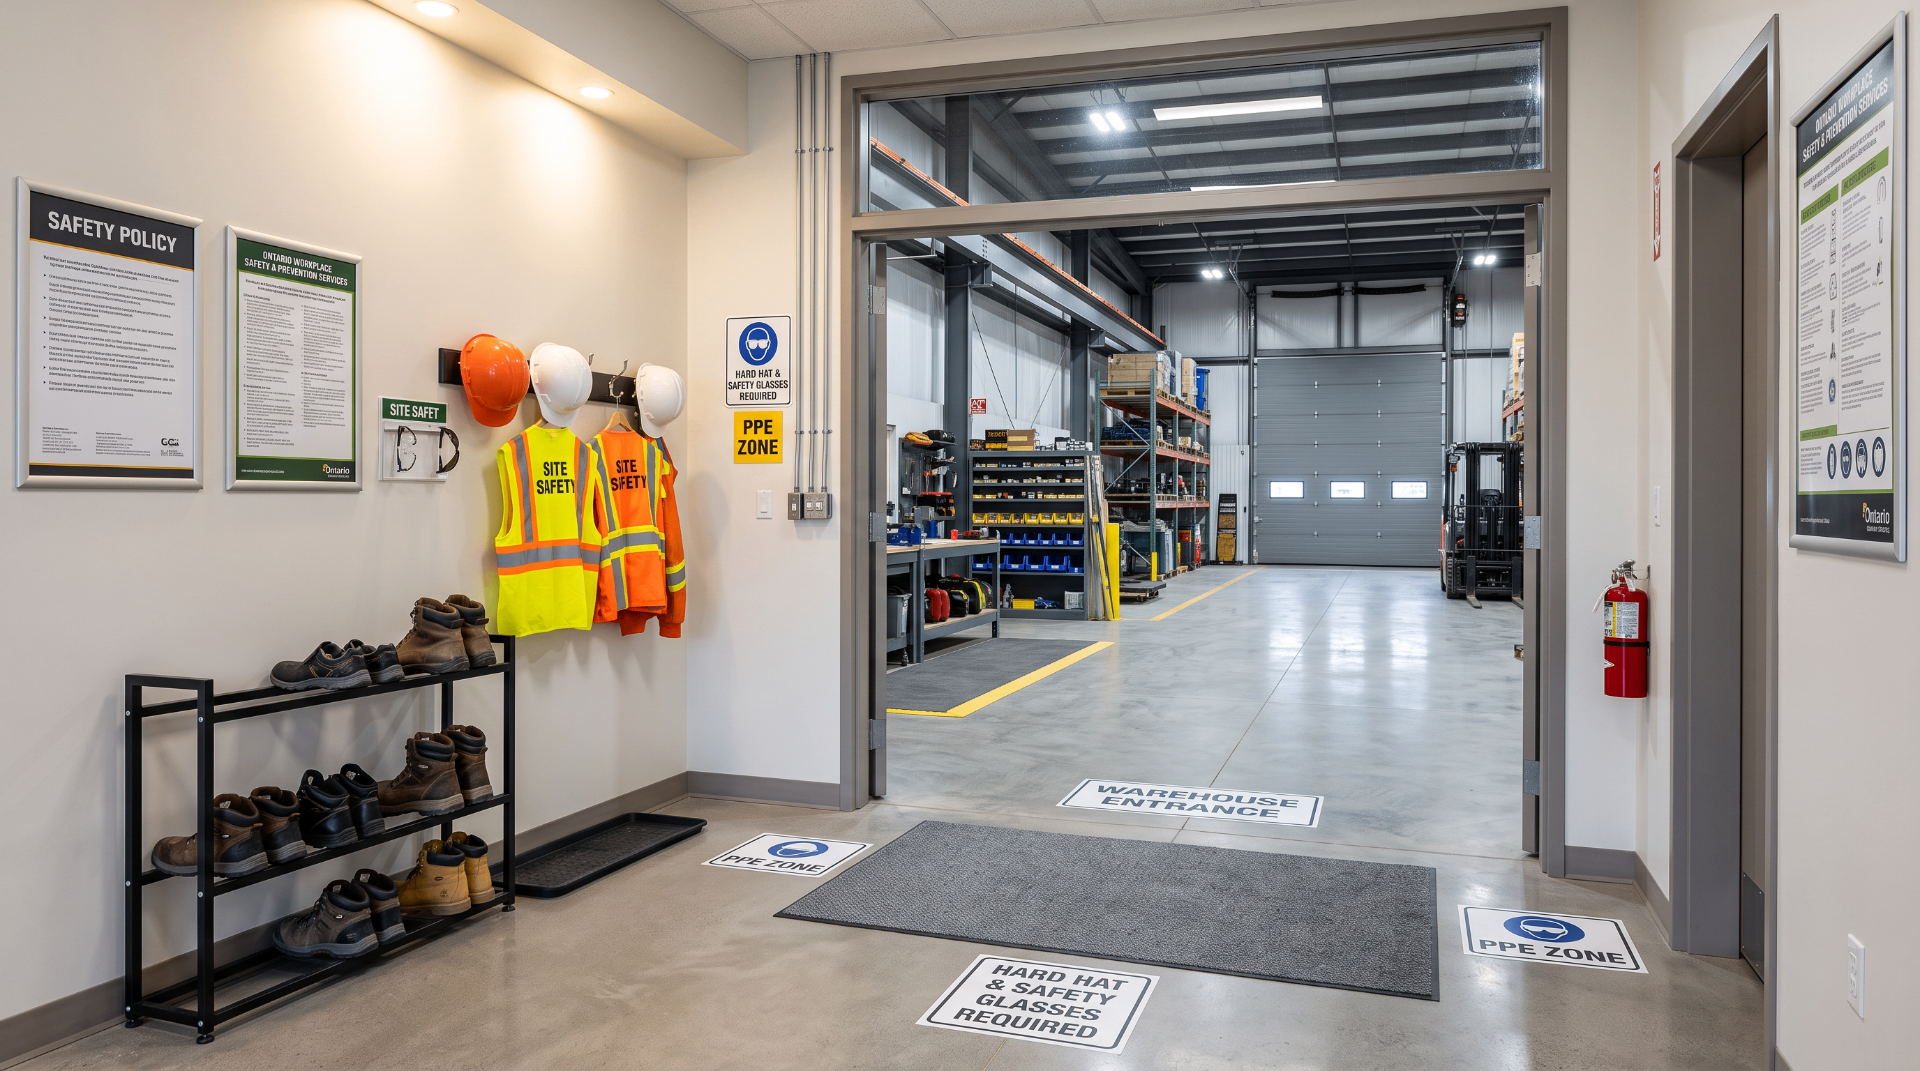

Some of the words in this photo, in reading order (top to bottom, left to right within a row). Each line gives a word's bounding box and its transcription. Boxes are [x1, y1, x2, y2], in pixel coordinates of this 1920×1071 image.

[48, 211, 115, 241] SAFETY
[120, 226, 177, 253] POLICY
[263, 251, 291, 264] ONTARIO
[293, 258, 332, 273] WORKPLACE
[245, 258, 269, 270] SAFETY
[278, 265, 317, 280] PREVENTION
[319, 273, 347, 286] SERVICES
[735, 370, 756, 379] HARD
[758, 369, 773, 378] HAT
[775, 369, 780, 378] &
[728, 381, 754, 390] SAFETY
[756, 380, 788, 389] GLASSES
[740, 392, 777, 401] REQUIRED
[390, 404, 410, 417] SITE
[412, 406, 440, 420] SAFET
[743, 420, 773, 435] PPE
[738, 439, 778, 455] ZONE
[325, 466, 350, 474] Ontario
[543, 461, 567, 476] SITE
[616, 459, 638, 474] SITE
[536, 479, 576, 494] SAFETY
[1864, 507, 1890, 525] Ontario
[1097, 785, 1300, 808] WAREHOUSE
[1100, 796, 1280, 818] ENTRANCE
[721, 855, 764, 866] PPE
[765, 860, 826, 873] ZONE
[1479, 939, 1536, 955] PPE
[1544, 945, 1626, 965] ZONE
[992, 964, 1066, 983] HARD
[1072, 974, 1128, 992] HAT
[984, 979, 1006, 991] &
[1011, 982, 1117, 1006] SAFETY
[976, 994, 1101, 1021] GLASSES
[953, 1007, 1098, 1039] REQUIRED
